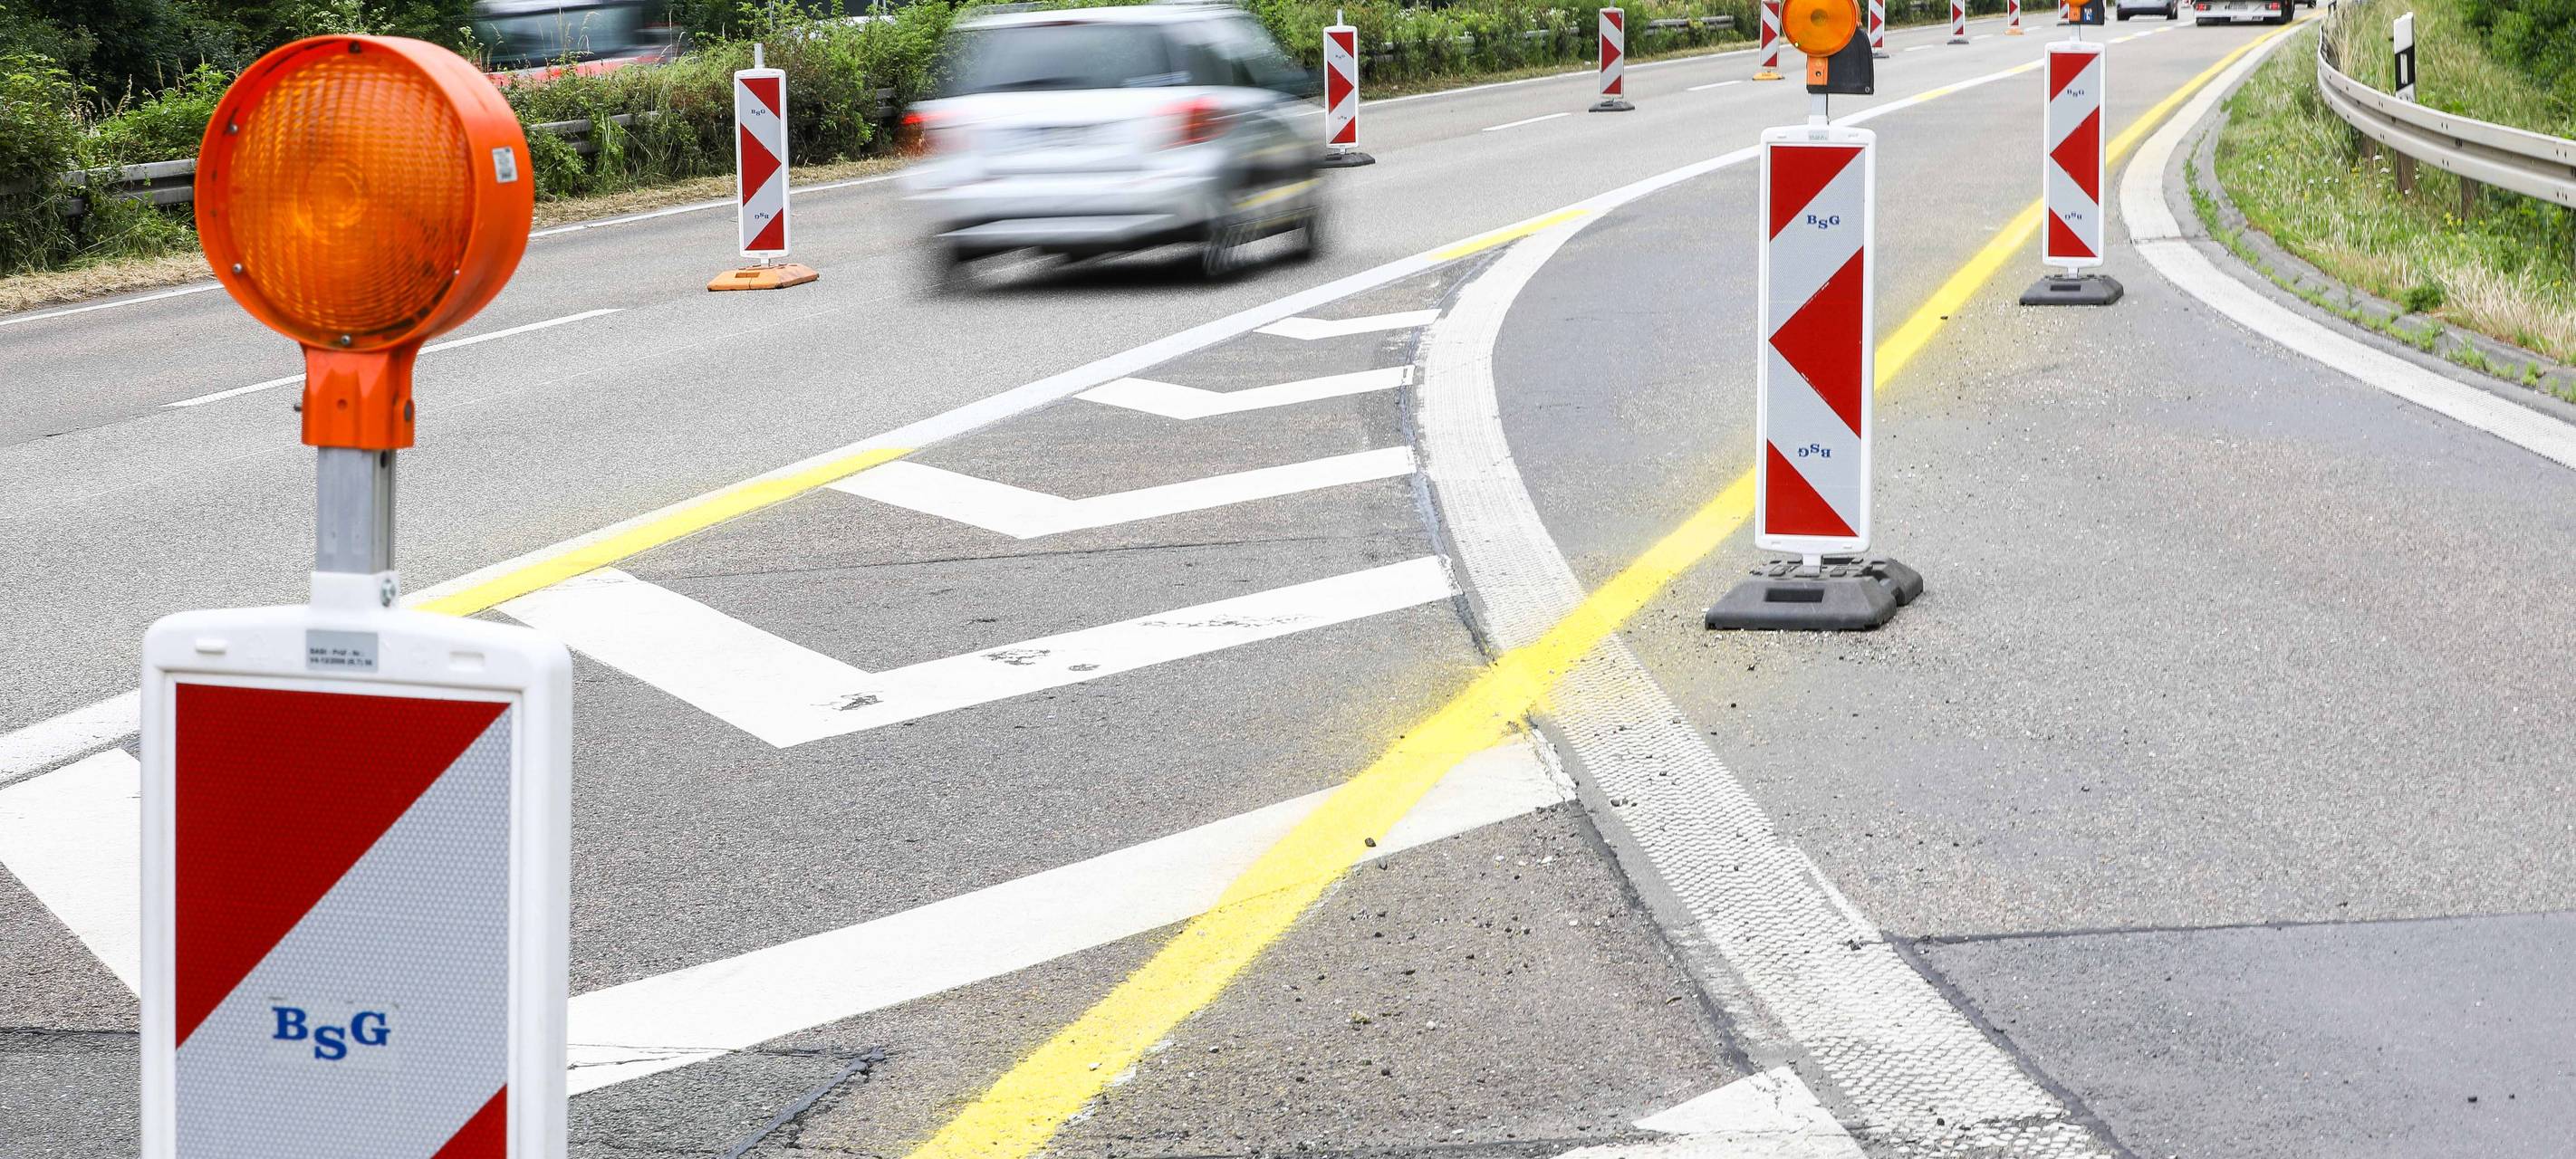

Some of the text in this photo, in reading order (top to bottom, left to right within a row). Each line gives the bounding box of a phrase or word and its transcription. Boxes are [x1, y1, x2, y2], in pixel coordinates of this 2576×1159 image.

[1807, 215, 1840, 228] BSG
[1798, 444, 1831, 457] BSG
[272, 1007, 390, 1060] BSG
